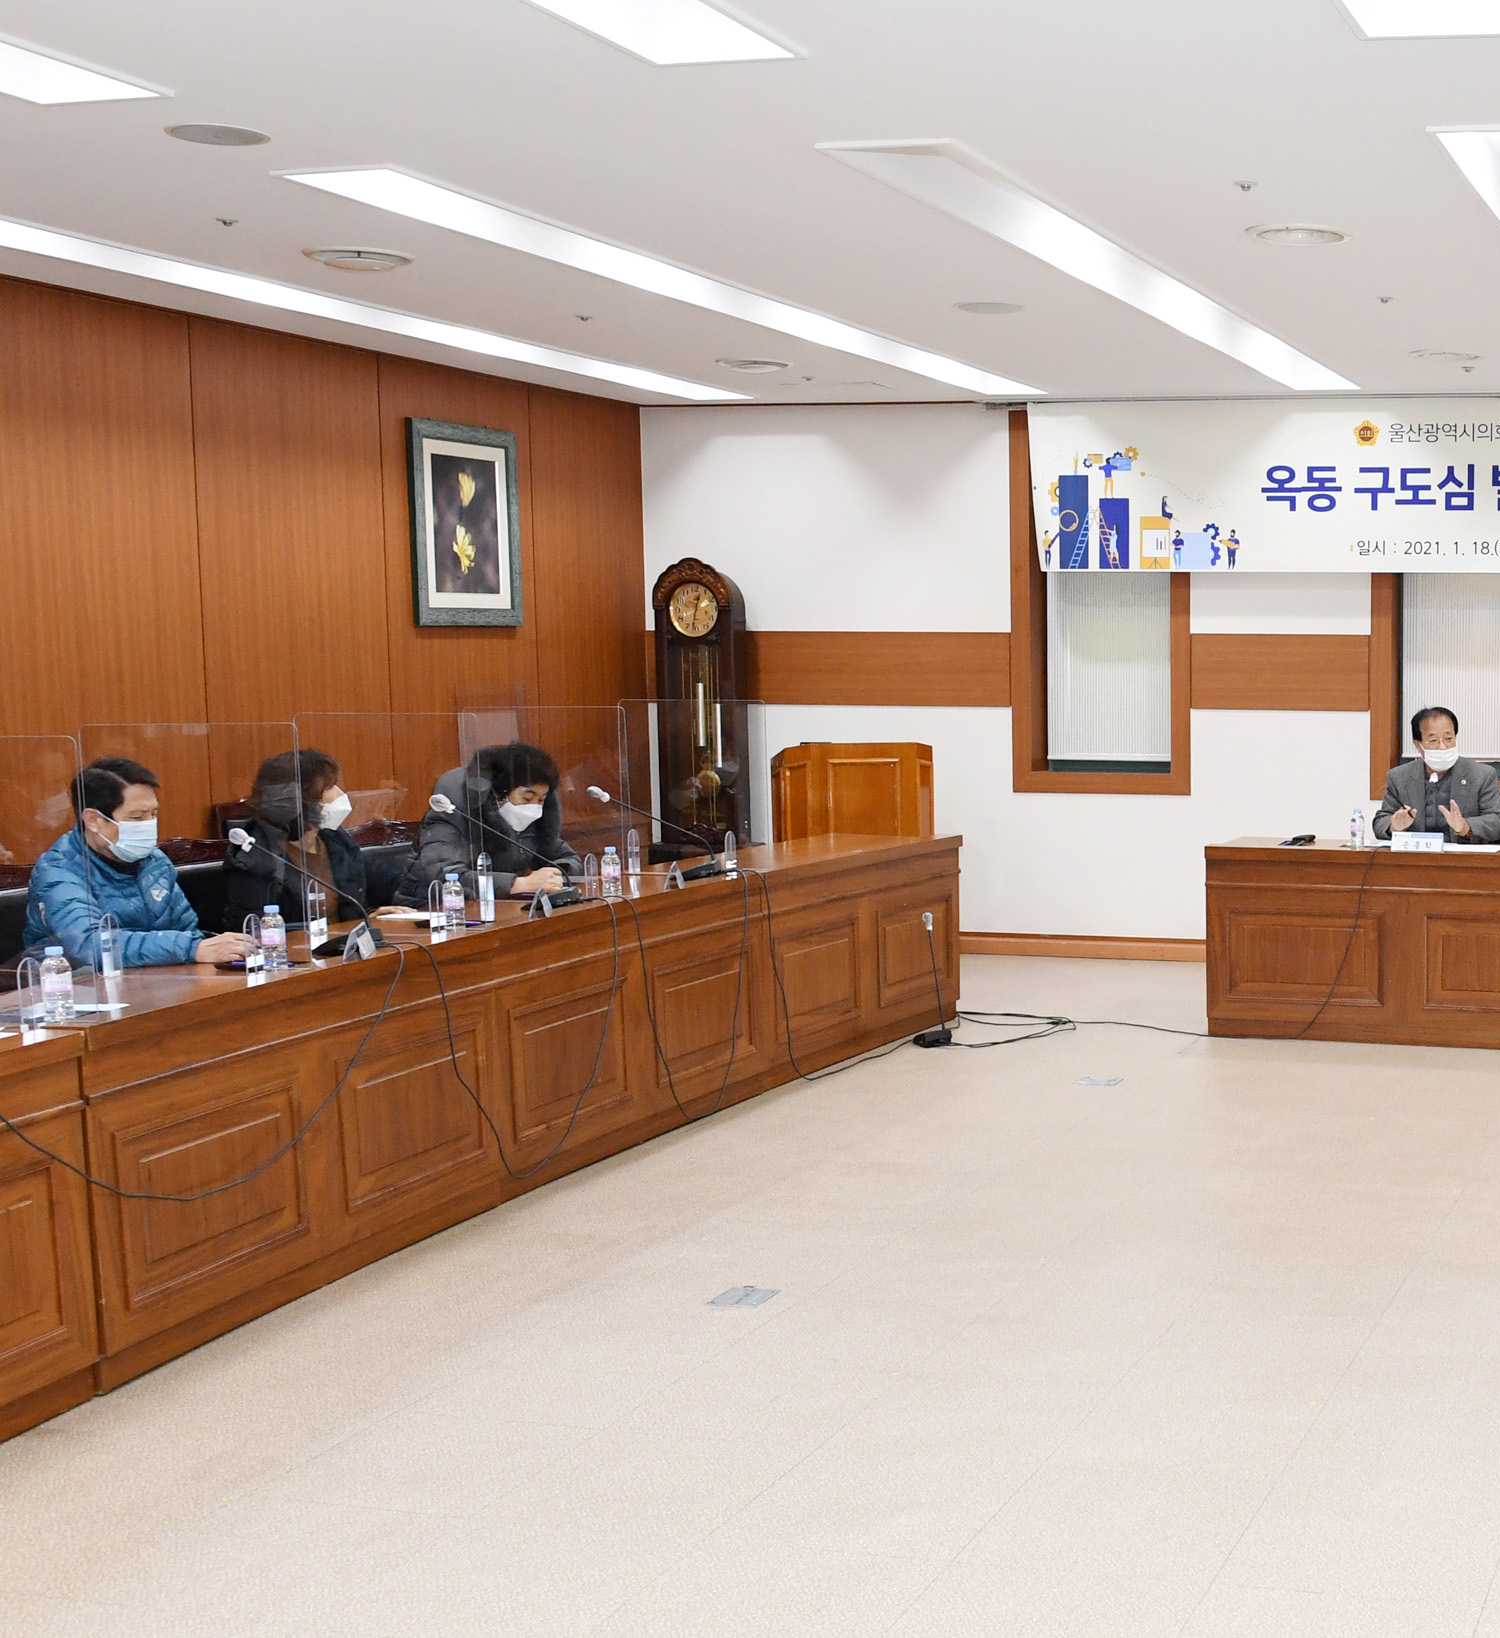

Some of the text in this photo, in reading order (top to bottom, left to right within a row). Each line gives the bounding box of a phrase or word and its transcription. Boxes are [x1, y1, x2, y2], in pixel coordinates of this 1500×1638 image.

[1261, 464, 1342, 512] 옥동
[1354, 463, 1475, 511] 구도심
[1356, 539, 1386, 556] 일시
[1403, 540, 1446, 556] 2021.
